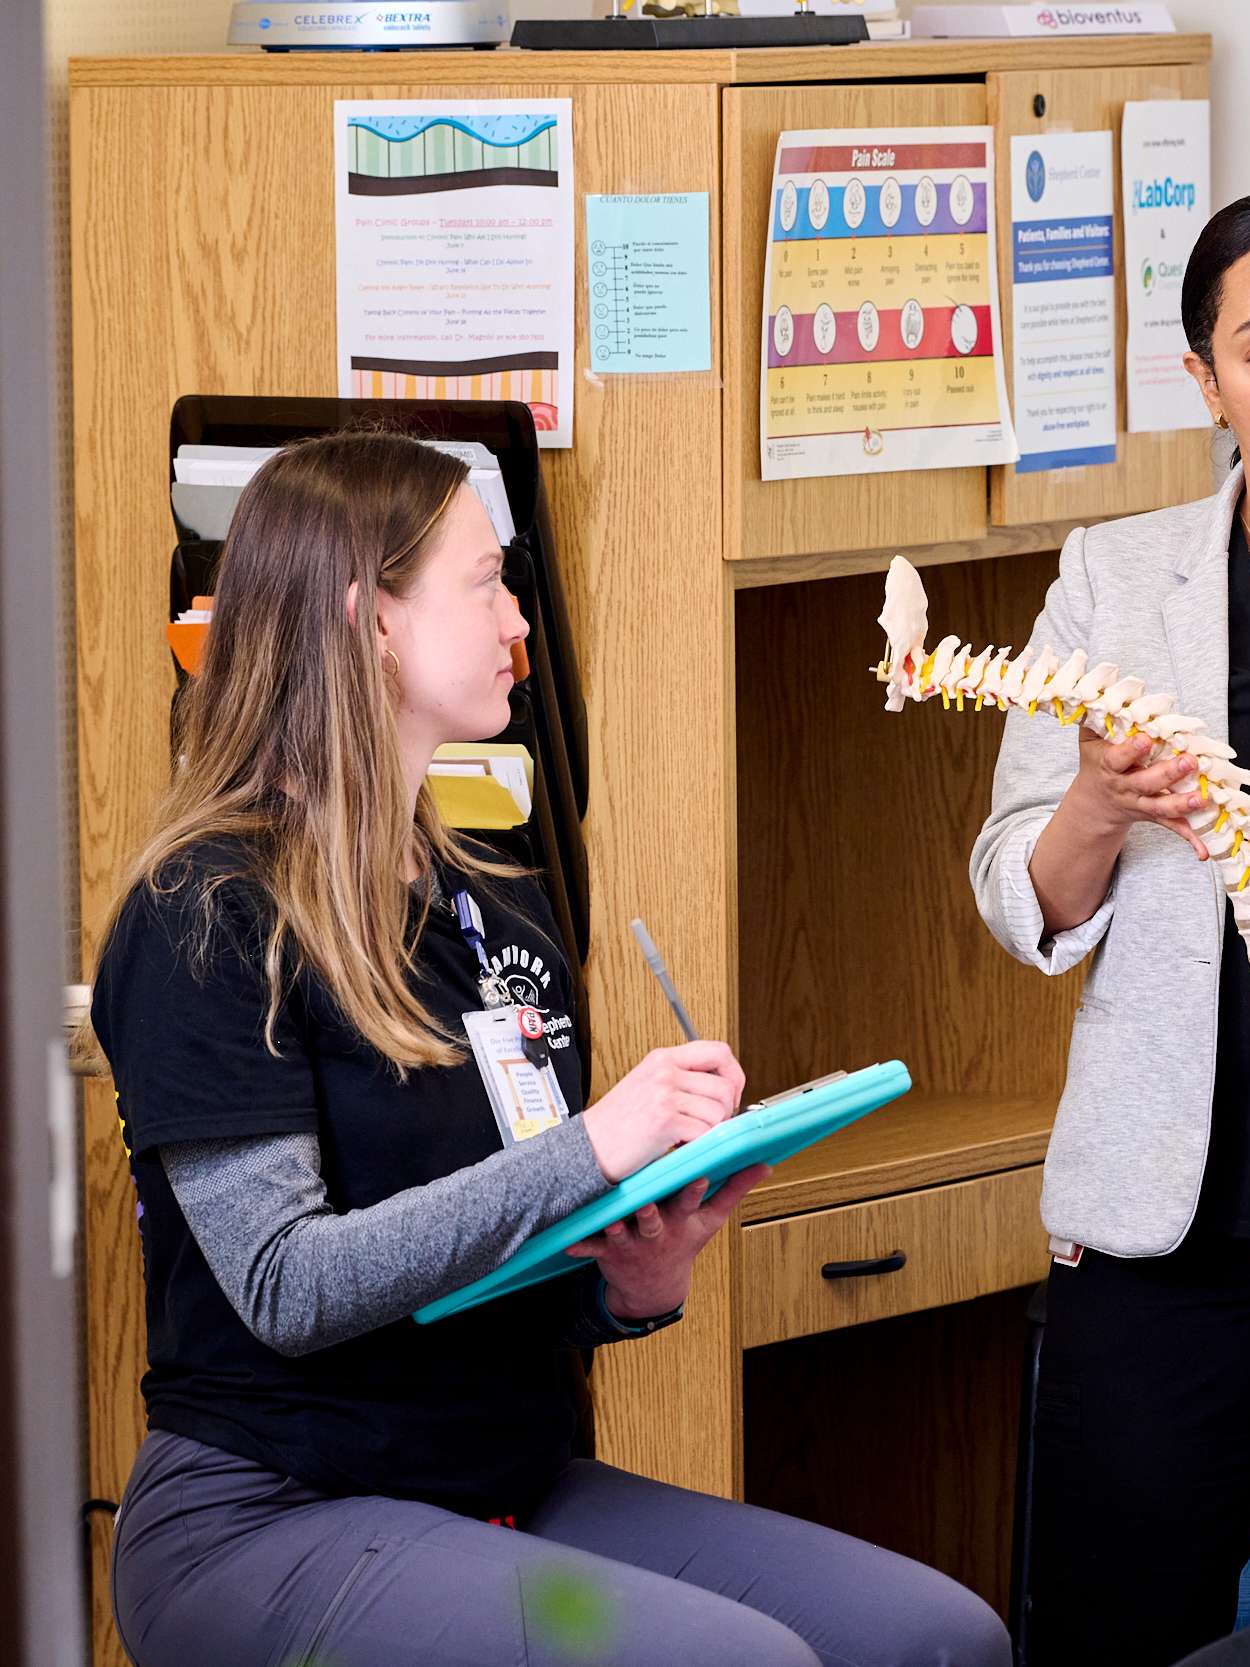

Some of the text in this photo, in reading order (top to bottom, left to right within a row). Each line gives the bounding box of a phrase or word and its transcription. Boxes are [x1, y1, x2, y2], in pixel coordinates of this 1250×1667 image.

[294, 13, 366, 25] CELEBREX
[385, 13, 431, 22] BEXTRA
[1057, 8, 1142, 25] bioventus
[851, 148, 896, 168] Pain Scale
[635, 196, 661, 204] DOLOR
[1138, 177, 1195, 211] LabCorp
[1072, 226, 1084, 240] and
[815, 248, 820, 261] 1
[850, 247, 857, 260] 2
[887, 245, 893, 259] 3
[923, 244, 929, 257] 4
[959, 242, 965, 256] 5
[866, 371, 872, 384] 8
[909, 368, 915, 382] 9
[954, 365, 965, 380] 10
[823, 373, 829, 387] 7
[490, 944, 551, 990] AVIORA
[543, 1014, 572, 1036] epherd
[547, 1034, 571, 1050] Cente
